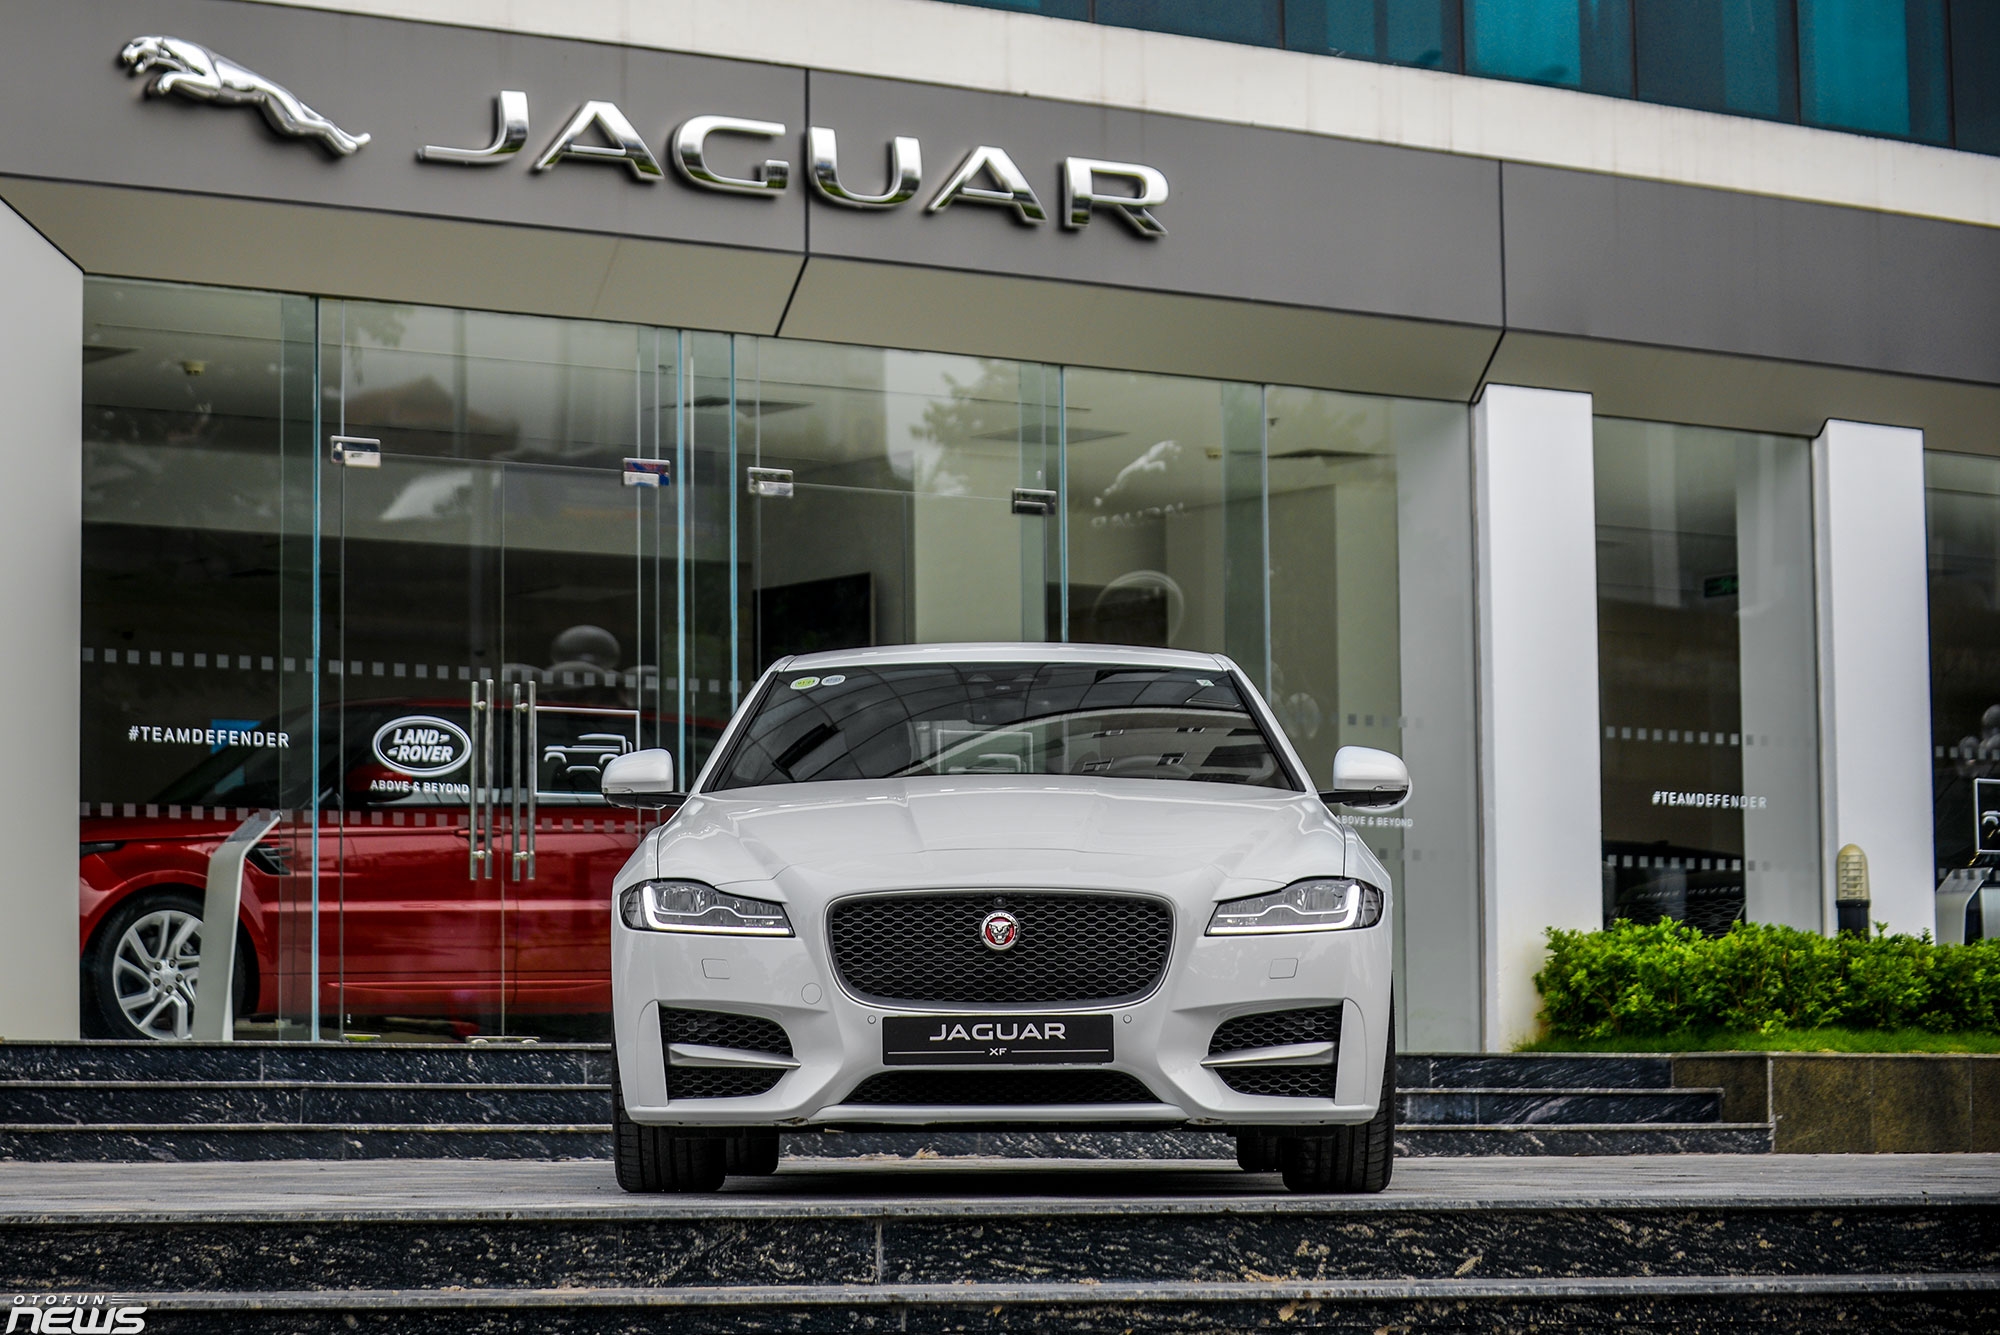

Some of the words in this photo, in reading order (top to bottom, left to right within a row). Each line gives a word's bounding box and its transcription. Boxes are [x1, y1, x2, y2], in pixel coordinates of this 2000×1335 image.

[417, 89, 1169, 237] JAGUAR
[128, 725, 290, 749] #TEAMDEFENDER
[392, 728, 440, 746] LAND
[396, 745, 454, 763] ROVER
[370, 779, 411, 793] ABOVE
[412, 781, 420, 793] &
[423, 781, 470, 795] BEYOND
[1652, 790, 1768, 809] #TEAMDEFENDER
[1367, 816, 1375, 828] &
[1376, 816, 1414, 828] BEYOND
[929, 1022, 1066, 1041] JAGUAR
[988, 1047, 1007, 1056] XF
